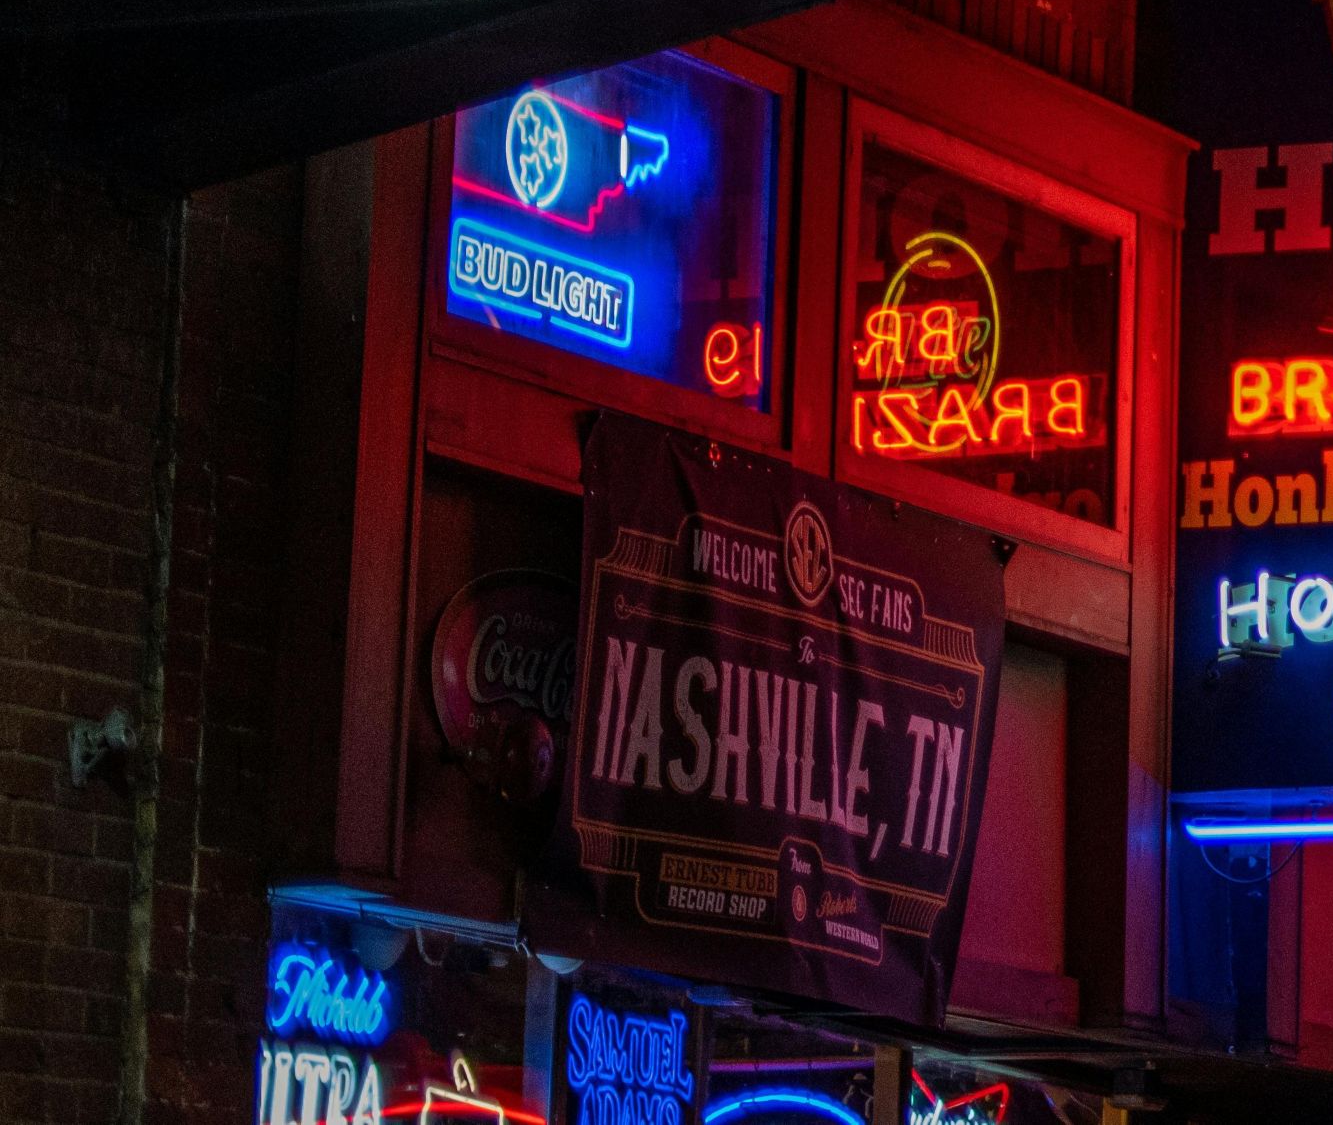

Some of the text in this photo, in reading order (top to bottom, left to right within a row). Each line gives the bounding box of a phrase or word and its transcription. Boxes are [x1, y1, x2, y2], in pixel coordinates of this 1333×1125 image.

[456, 235, 623, 331] BUD LIGHT
[693, 529, 913, 634] WELCOME SEC FANS
[791, 514, 828, 594] SEC
[592, 636, 965, 861] NASHVILLE, TN
[662, 856, 778, 893] ERNEST TUBB
[667, 884, 725, 916] RECORD
[728, 890, 768, 921] SHOP
[567, 997, 694, 1101] SAMUEL
